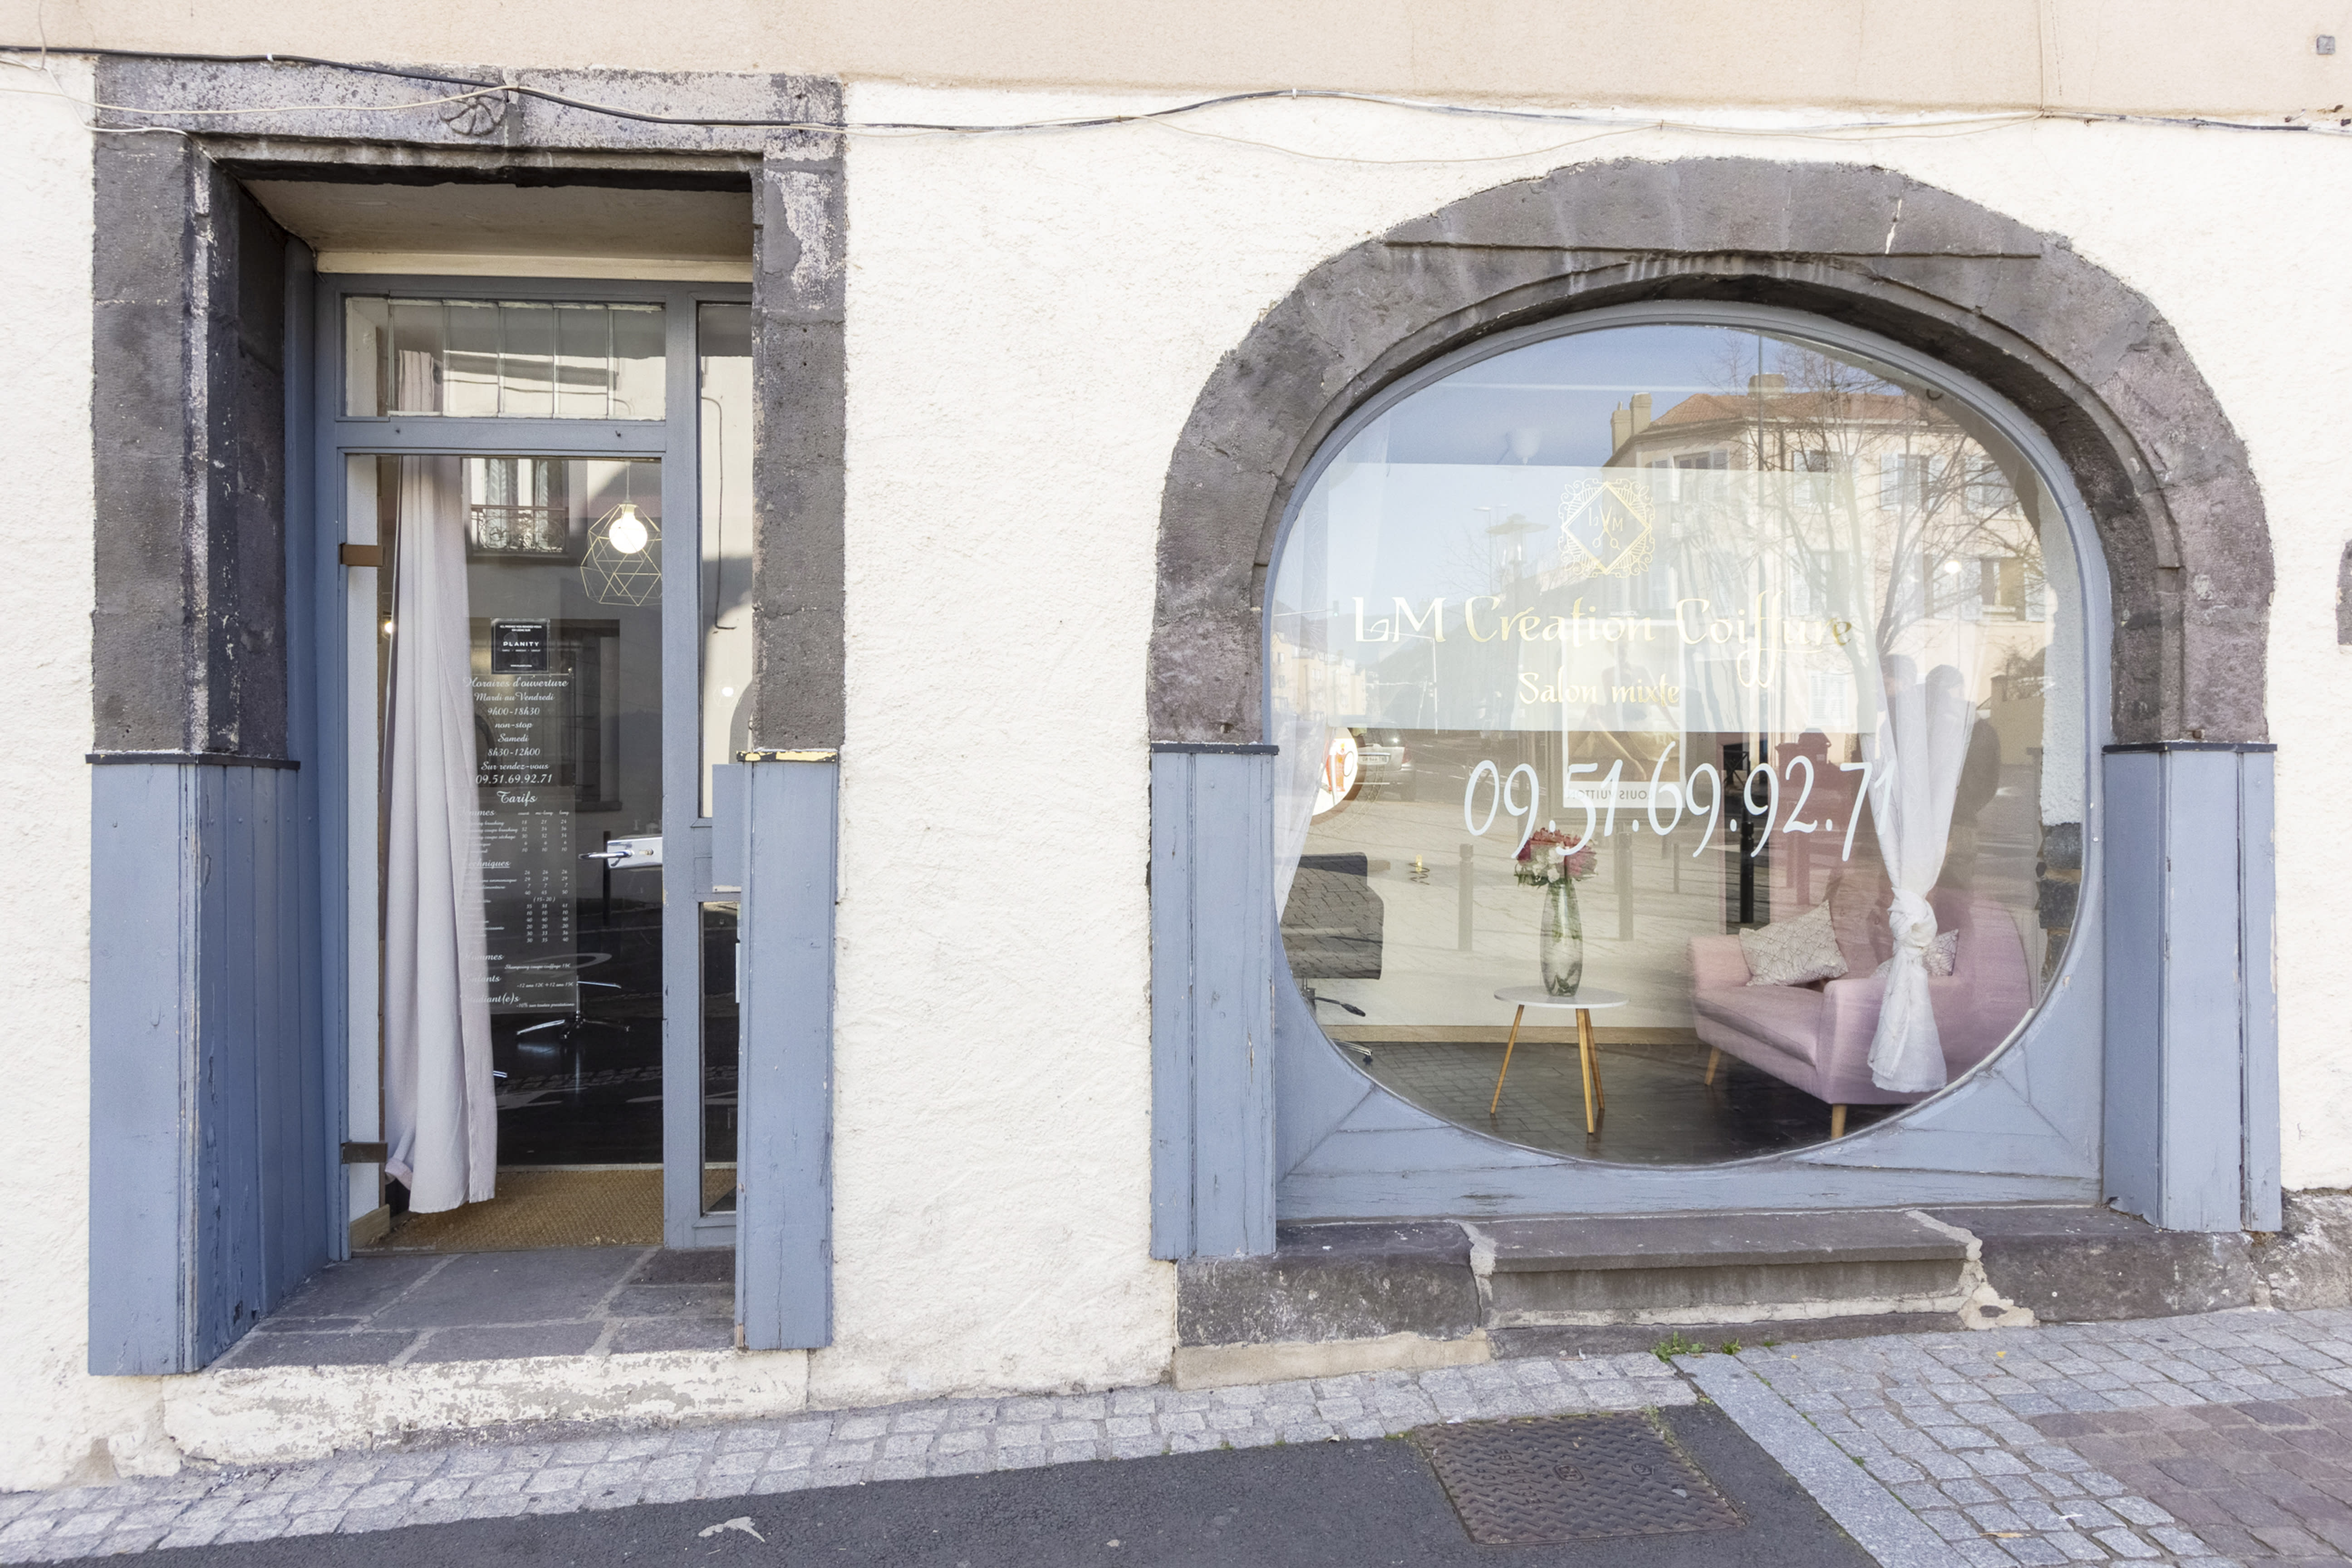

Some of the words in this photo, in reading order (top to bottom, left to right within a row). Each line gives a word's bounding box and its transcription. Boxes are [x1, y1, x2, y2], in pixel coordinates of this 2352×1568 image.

[1352, 596, 1446, 643] LM
[1675, 590, 1852, 688] Coiffure
[462, 676, 512, 687] Horaires
[513, 676, 569, 687] d'ouverture
[1518, 666, 1597, 704] Salon
[1612, 674, 1679, 707] mixte
[474, 692, 503, 701] Mardi
[515, 692, 555, 701] Vendredi
[487, 706, 540, 715] 9h00-18h30
[495, 721, 534, 730] non-stop
[497, 733, 530, 743] Samedi
[487, 747, 540, 756] 8h30-12h00
[481, 761, 498, 770] Sur
[499, 761, 550, 770] rendez-vous
[476, 774, 553, 784] 09.51.69.92.71
[496, 790, 538, 807] Tarifs
[1464, 741, 1897, 862] 09.51.69.92.71
